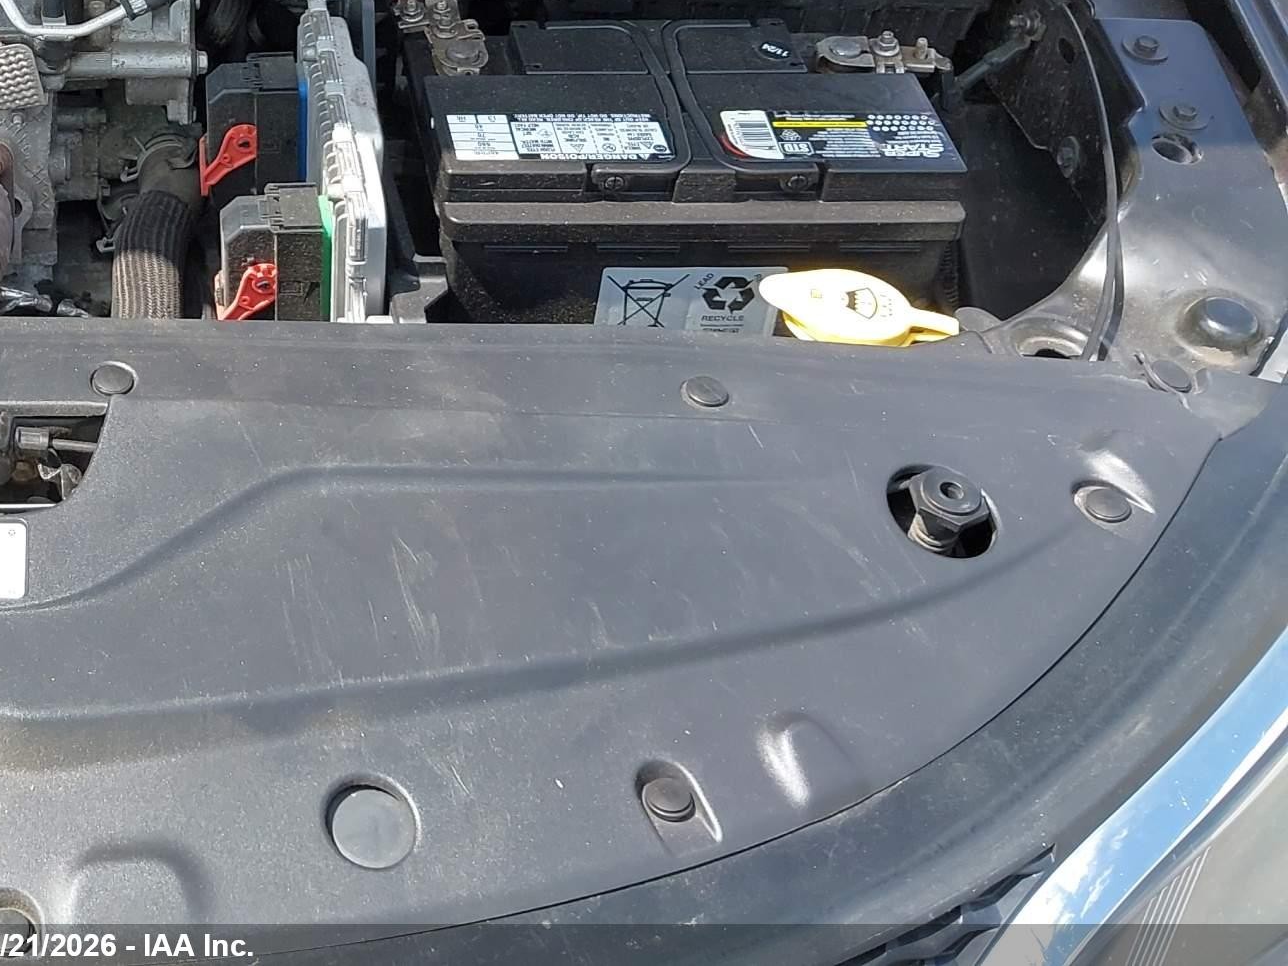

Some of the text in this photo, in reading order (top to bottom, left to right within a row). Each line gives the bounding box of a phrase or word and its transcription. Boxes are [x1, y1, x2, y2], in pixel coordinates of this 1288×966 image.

[882, 143, 944, 153] START
[884, 150, 941, 158] SUPER
[694, 273, 714, 289] LEAD
